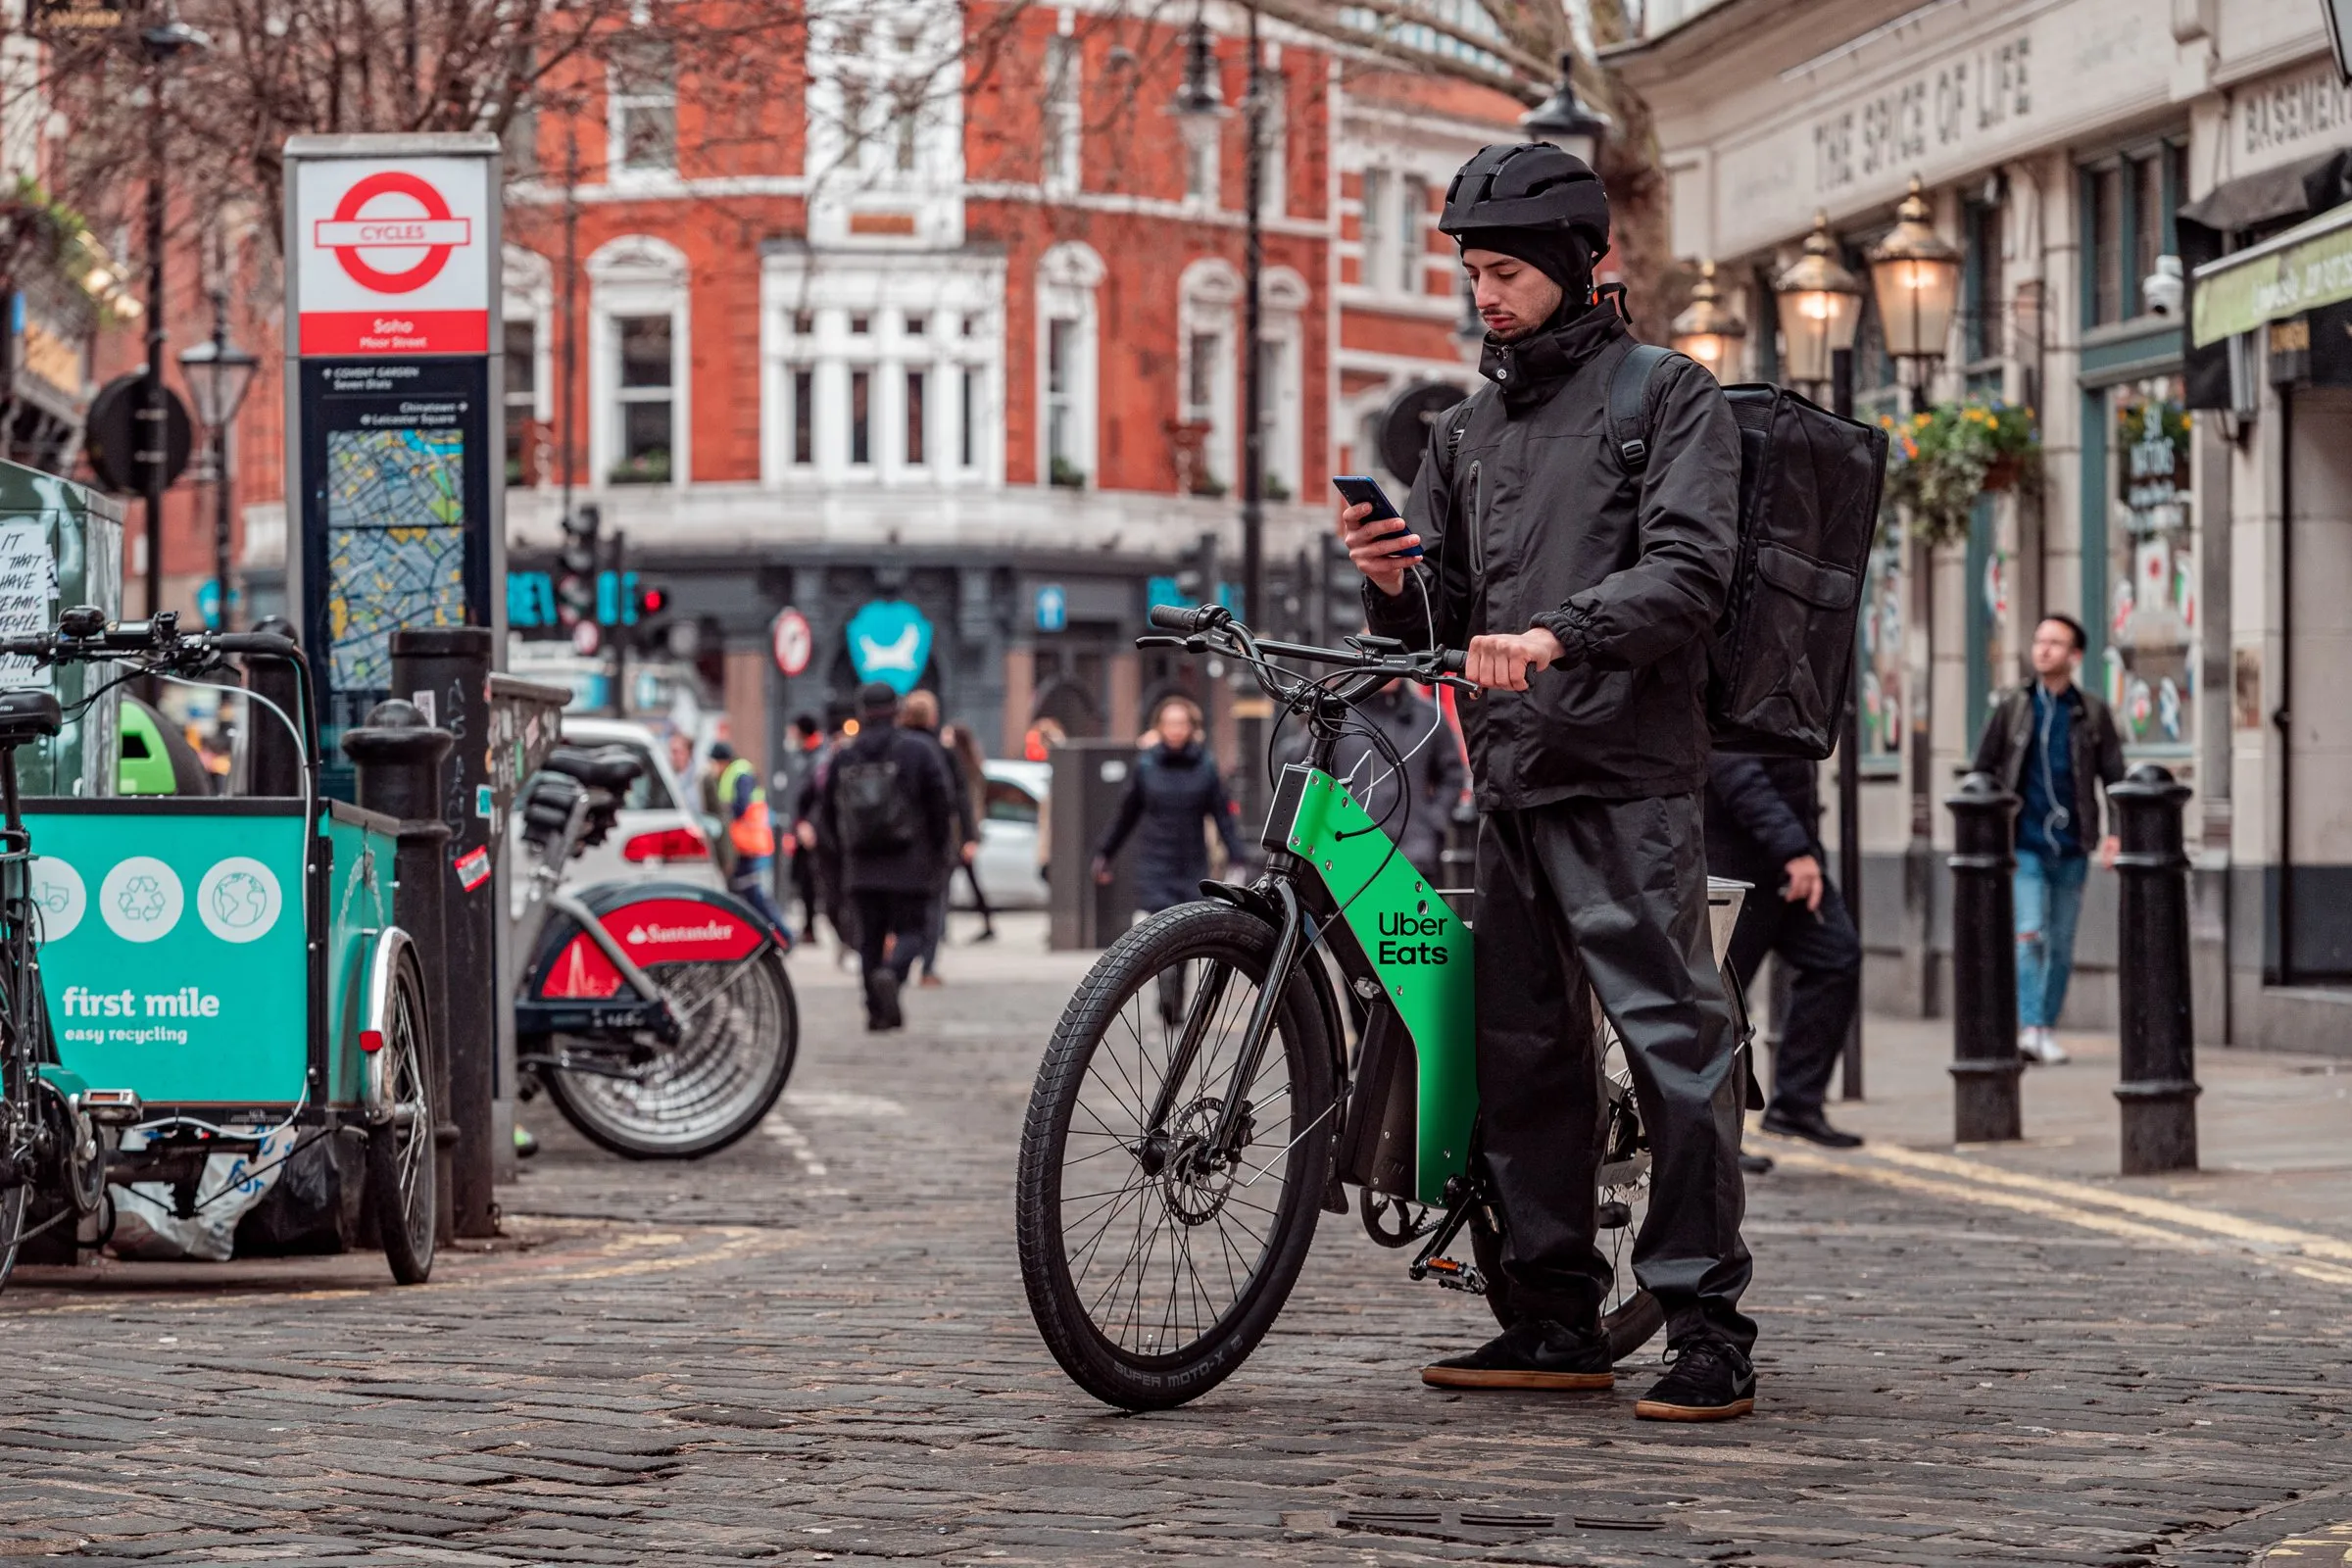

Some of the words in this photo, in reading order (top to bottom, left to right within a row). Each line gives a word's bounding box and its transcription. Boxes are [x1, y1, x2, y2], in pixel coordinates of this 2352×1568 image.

[1814, 112, 1853, 193] THE
[1864, 79, 1926, 175] SPICE
[1935, 63, 1967, 146] OF
[1977, 36, 2032, 130] LIFE
[2245, 73, 2352, 154] BASEMEN
[360, 224, 425, 241] CYCLES
[372, 318, 414, 334] Soho
[391, 336, 427, 348] Street
[1, 533, 25, 551] IT
[9, 553, 43, 569] THAT
[0, 572, 37, 590] HAVE
[0, 595, 42, 612] EAMS
[647, 919, 734, 943] Santander
[1379, 911, 1448, 936] Uber
[1379, 941, 1448, 965] Eats
[62, 986, 136, 1017] first
[144, 987, 220, 1017] mile
[65, 1028, 105, 1045] easy
[109, 1026, 188, 1045] recycling
[1113, 1360, 1161, 1388] SUPER
[1167, 1350, 1225, 1388] MOTO-X
